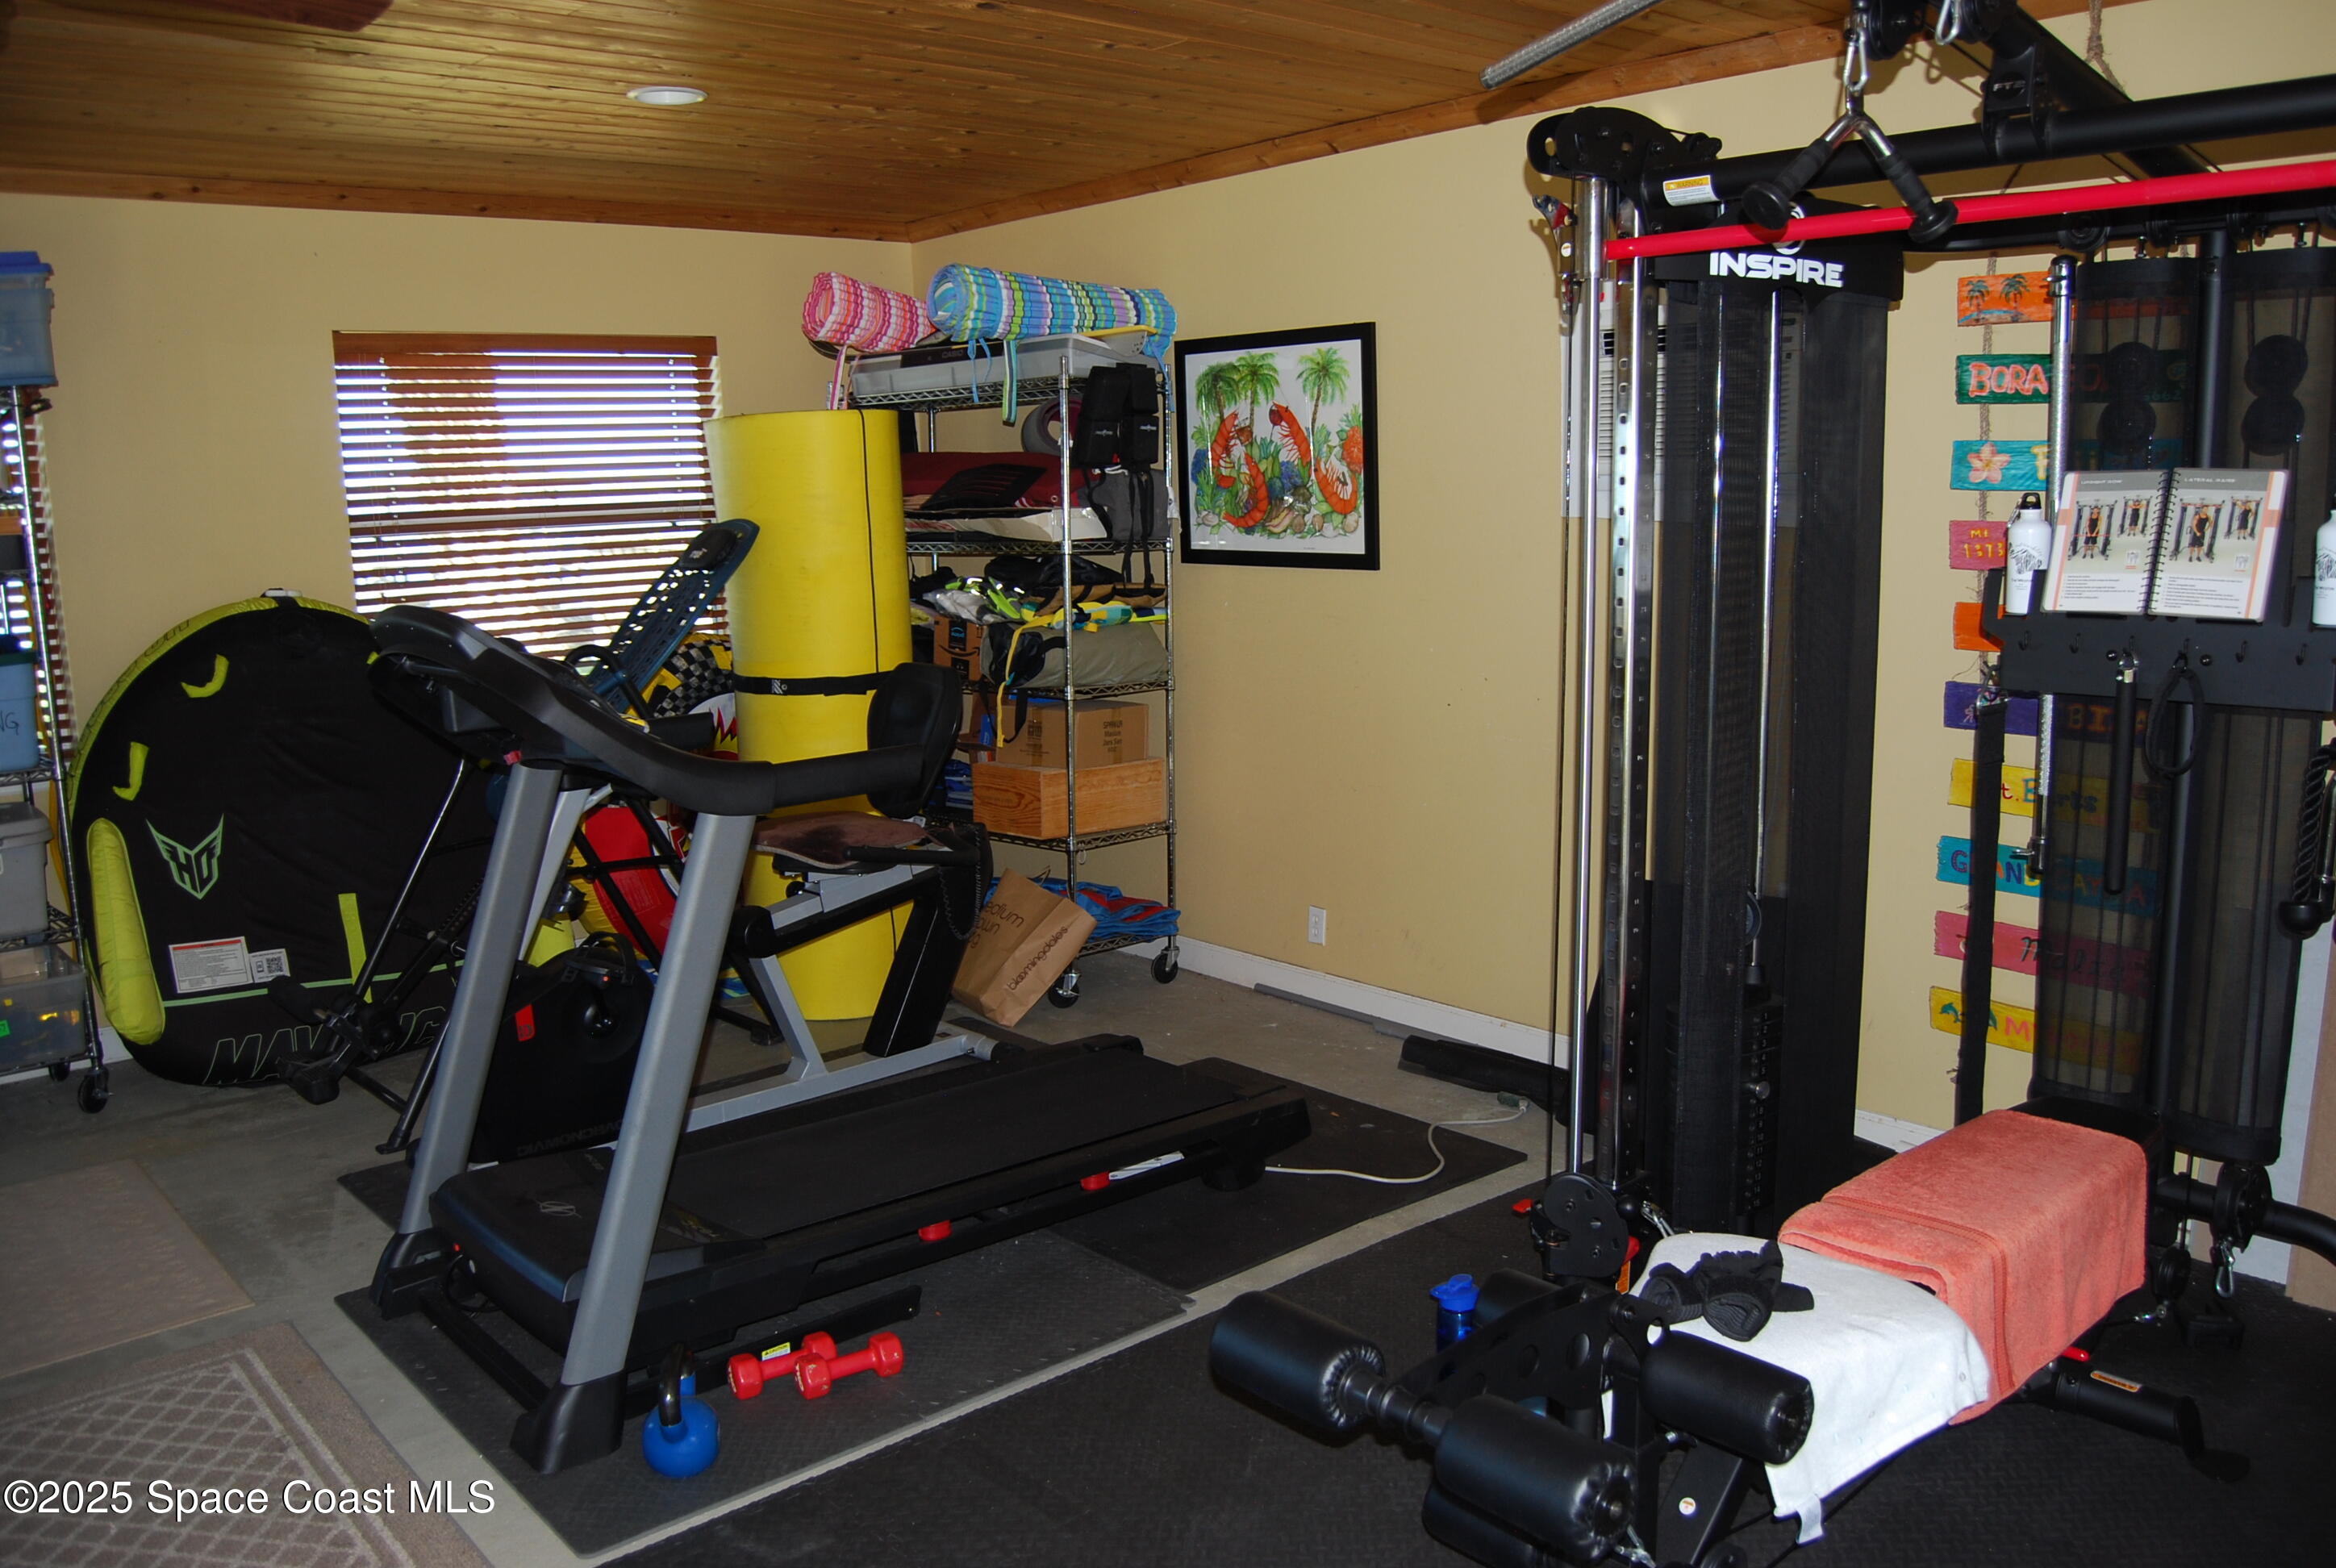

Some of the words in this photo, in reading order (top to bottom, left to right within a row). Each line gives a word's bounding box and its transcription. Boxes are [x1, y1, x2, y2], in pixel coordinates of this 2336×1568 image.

[1709, 251, 1844, 288] INSPIRE
[1968, 361, 2050, 398] BORA
[1950, 849, 2042, 886] GAND
[985, 900, 1024, 928] edium
[1007, 925, 1069, 991] bloomingdales
[515, 1120, 622, 1158] DIAMONDBA
